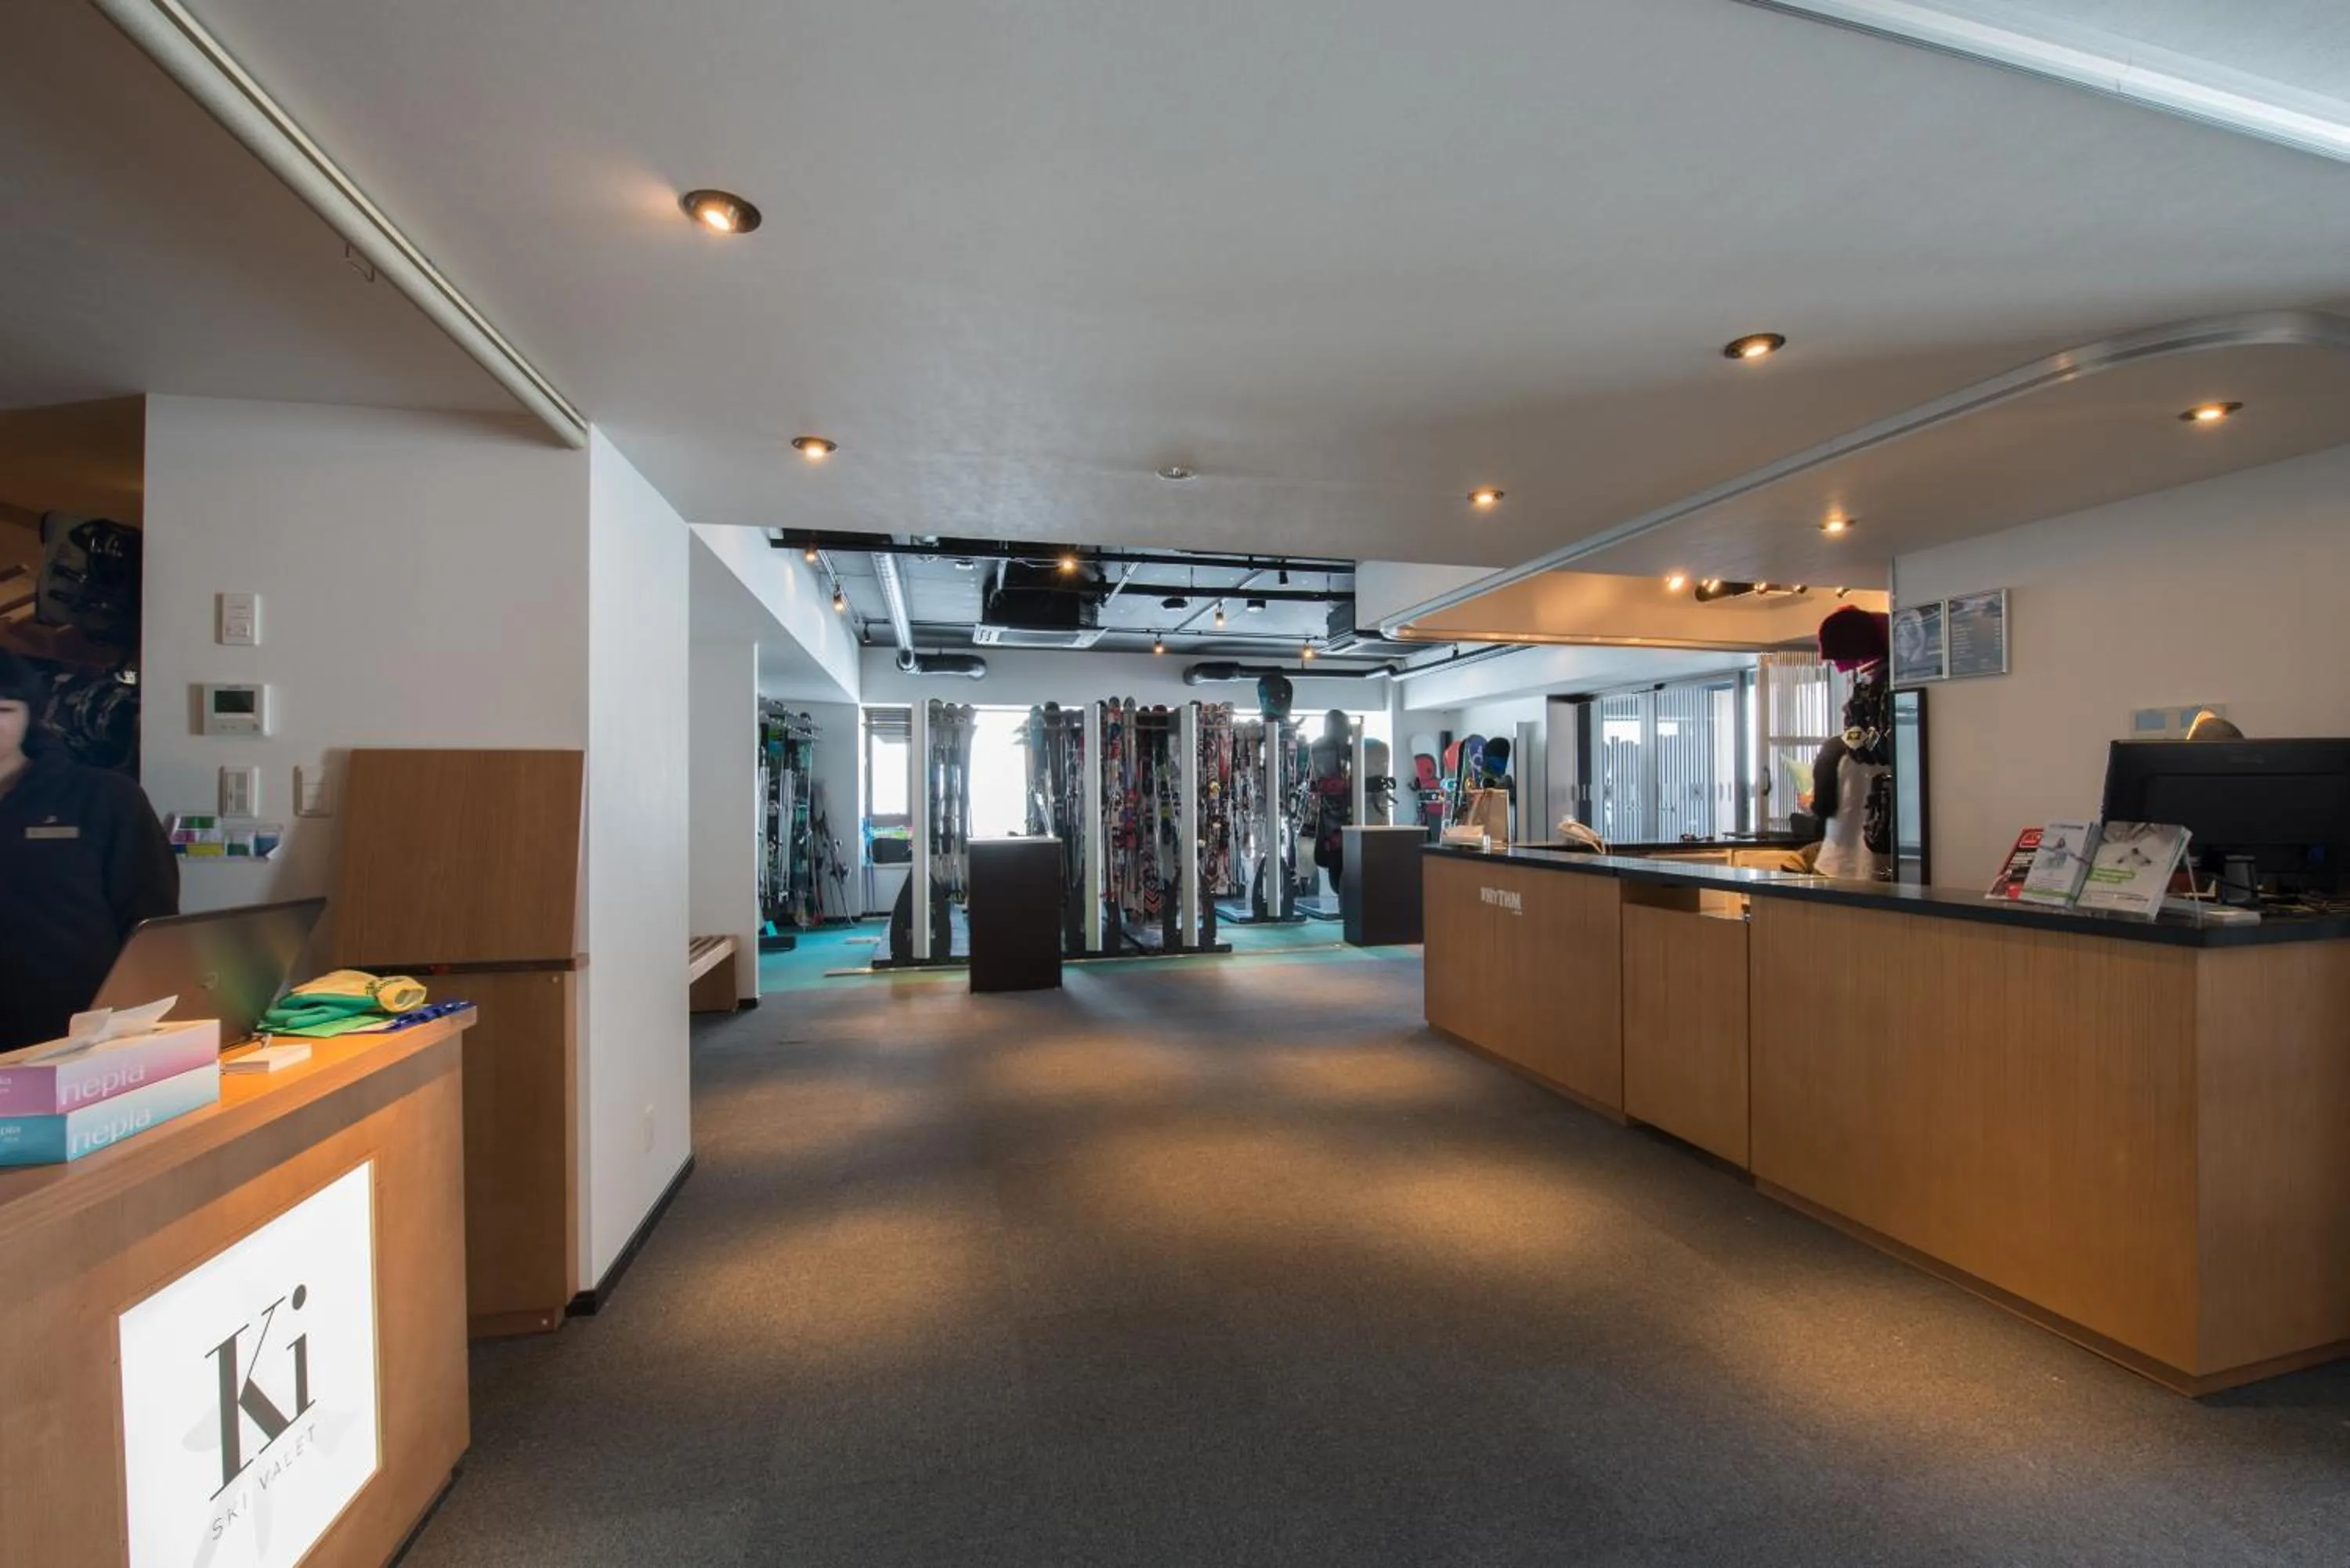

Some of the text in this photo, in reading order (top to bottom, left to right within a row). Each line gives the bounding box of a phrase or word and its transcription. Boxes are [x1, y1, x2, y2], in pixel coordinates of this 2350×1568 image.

[61, 1064, 145, 1105] nepia
[70, 1107, 152, 1154] nepia
[204, 1284, 316, 1501] Ki
[212, 1423, 316, 1541] SKI VALET
